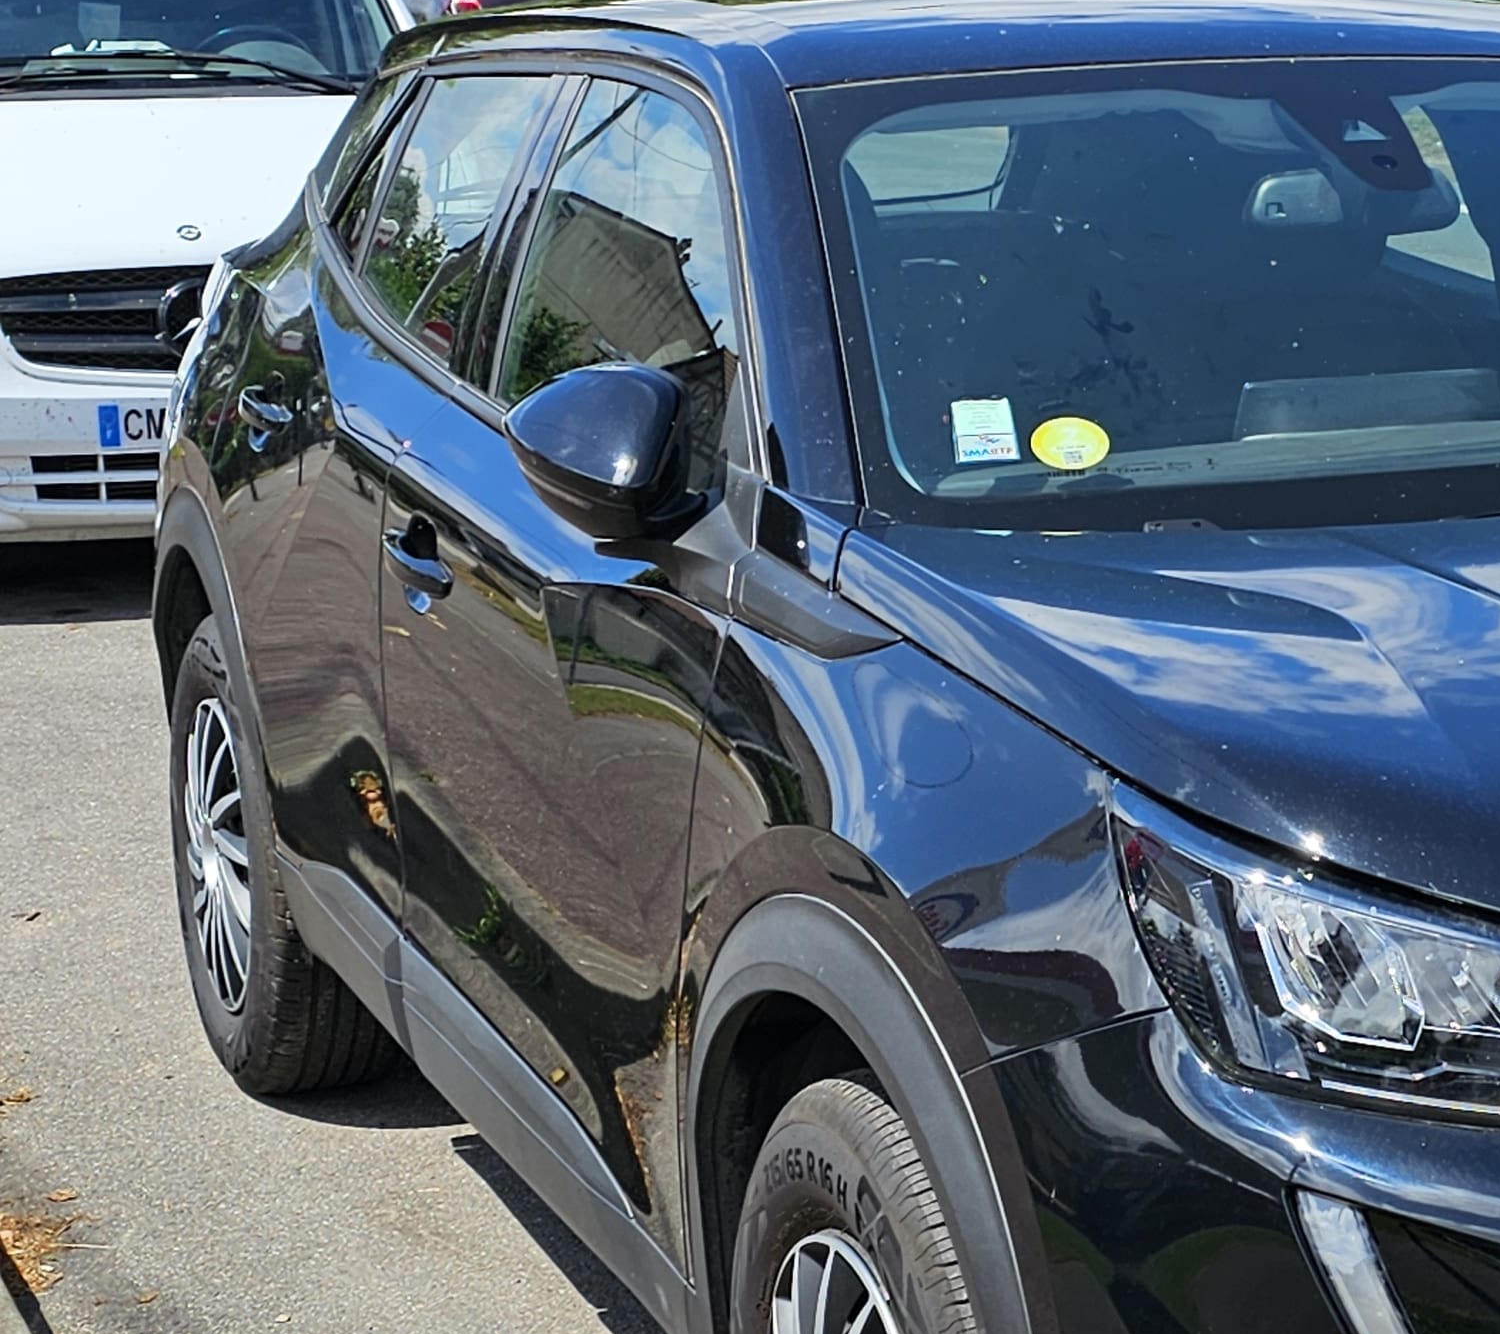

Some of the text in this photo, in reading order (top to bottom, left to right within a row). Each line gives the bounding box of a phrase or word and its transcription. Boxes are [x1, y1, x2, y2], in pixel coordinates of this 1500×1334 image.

[807, 1151, 818, 1185] R
[819, 1157, 833, 1195] 16
[837, 1173, 848, 1211] H
